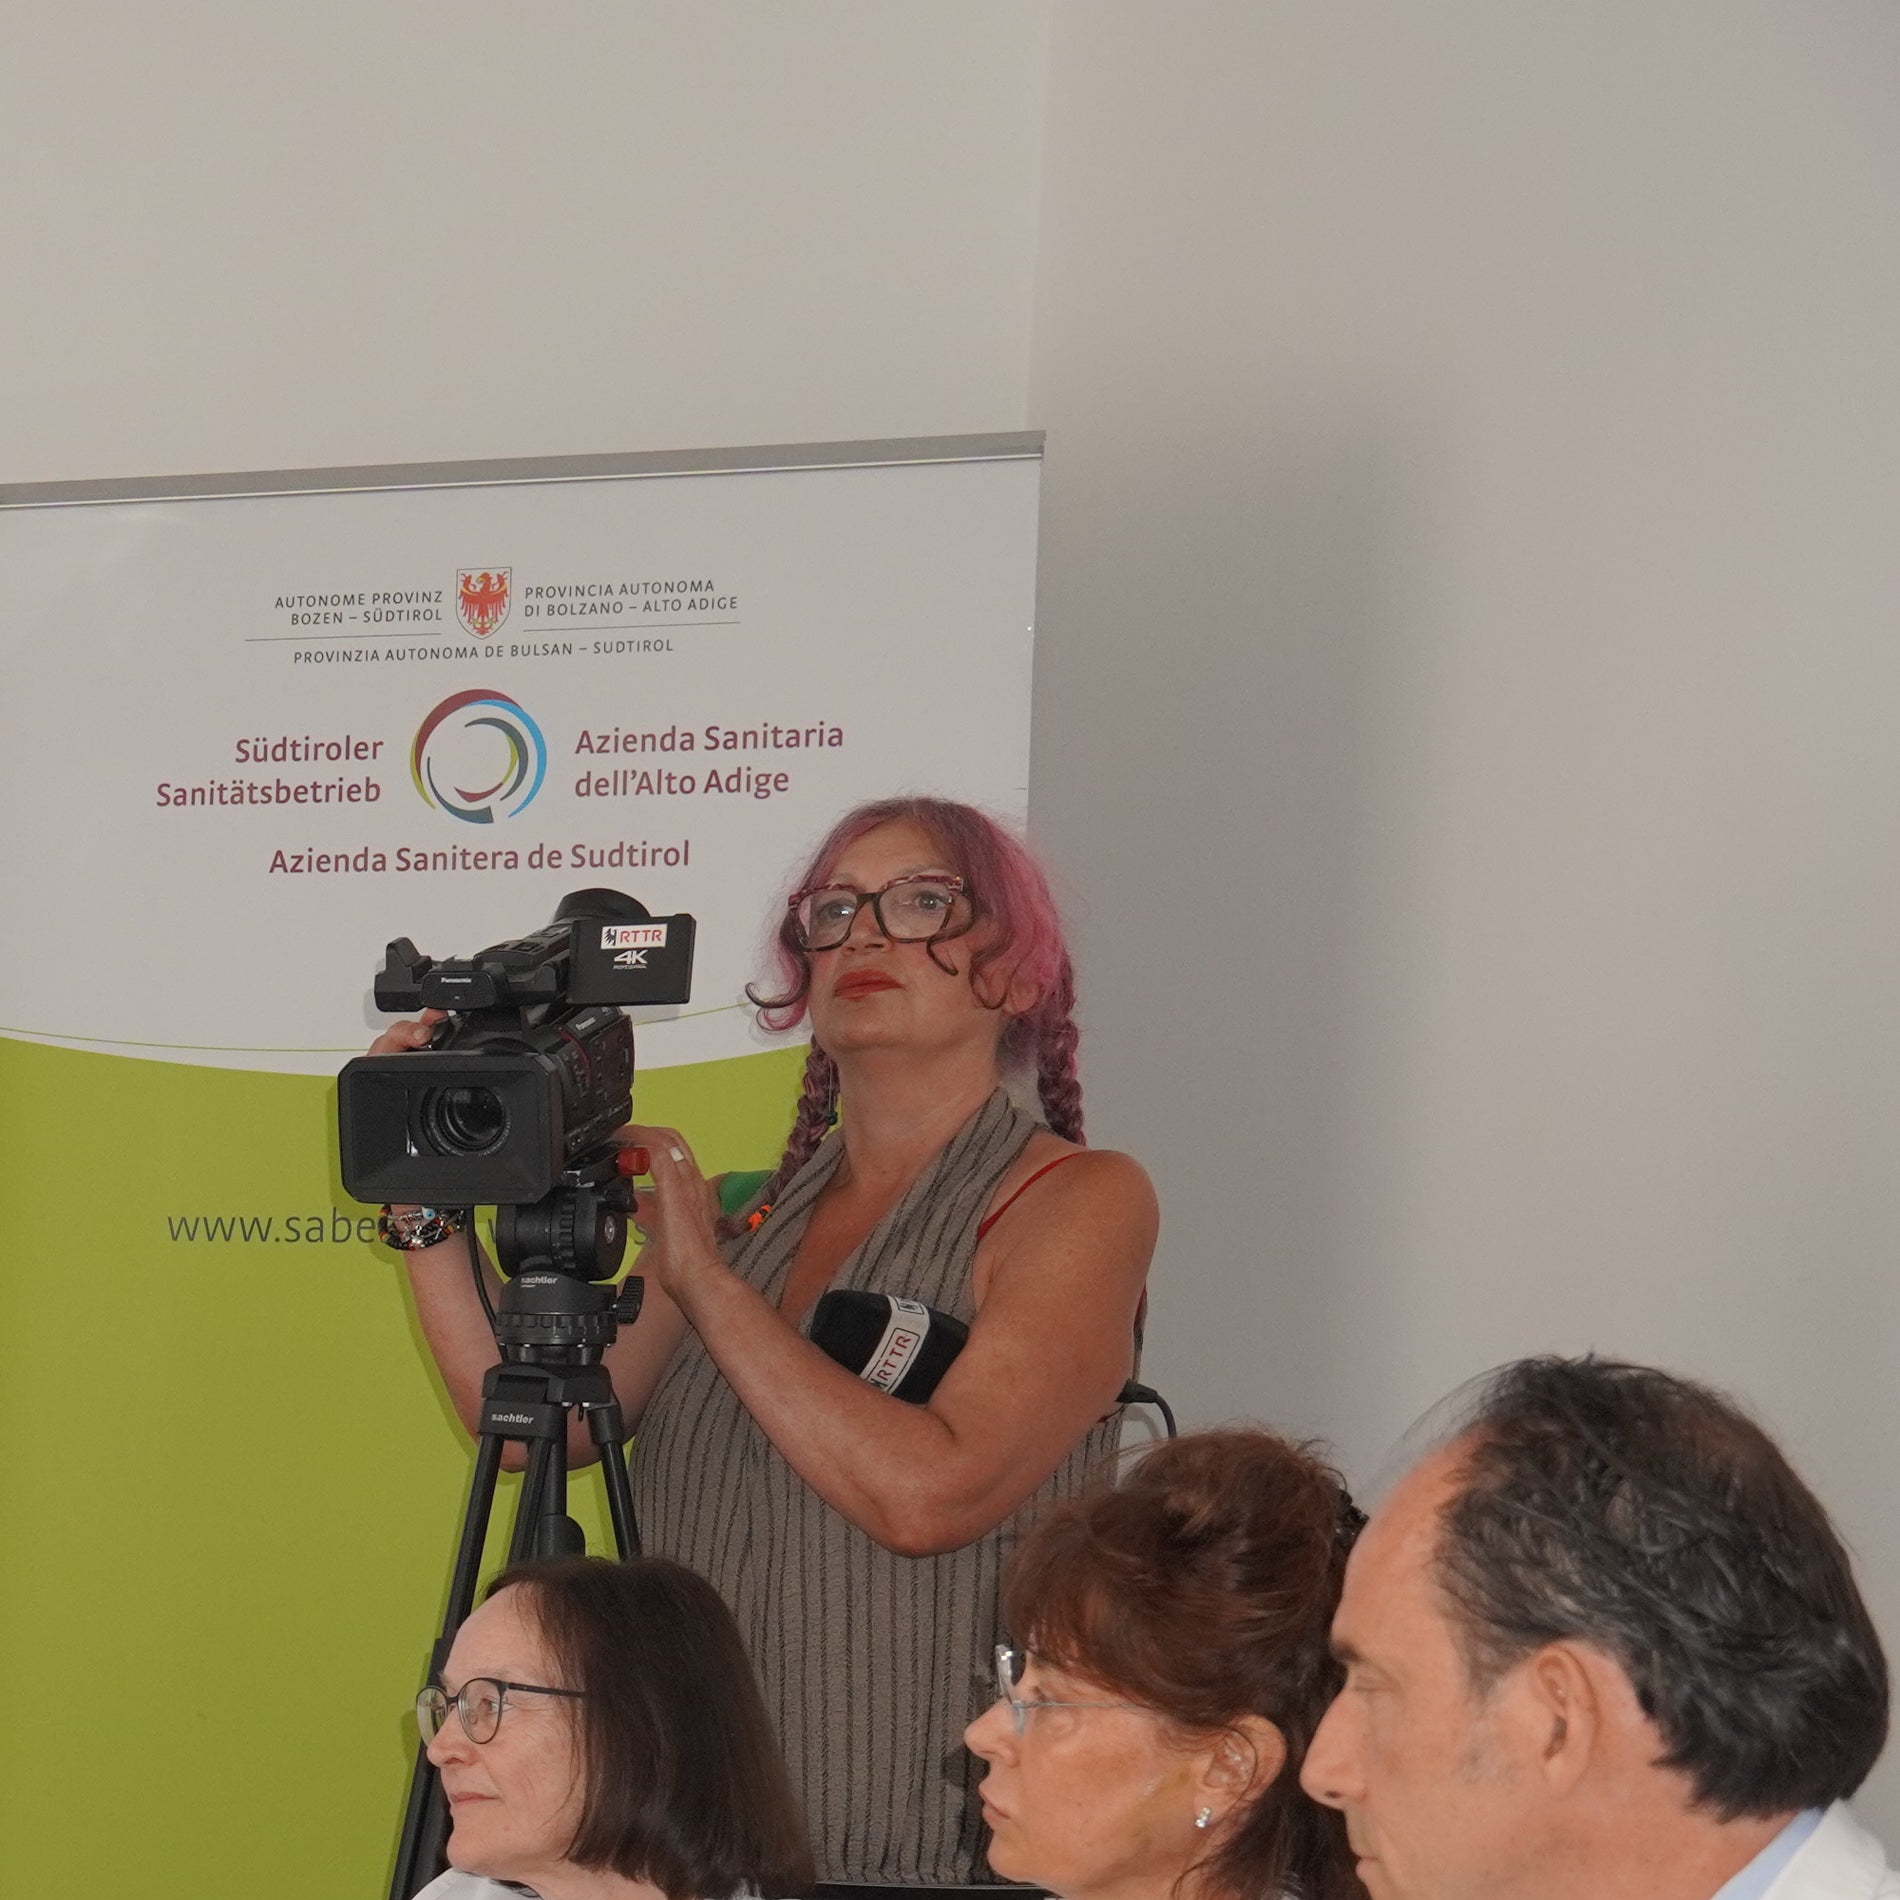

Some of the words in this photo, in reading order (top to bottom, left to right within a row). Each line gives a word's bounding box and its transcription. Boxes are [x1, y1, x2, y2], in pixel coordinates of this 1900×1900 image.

[274, 592, 366, 609] AUTONOME
[371, 590, 443, 605] PROVINZ
[524, 583, 614, 600] PROVINCIA
[618, 579, 715, 596] AUTONOMA
[290, 611, 343, 626] BOZEN
[362, 607, 443, 624] SÜDTIROL
[524, 604, 540, 618] DI
[546, 601, 624, 617] BOLZANO
[642, 598, 682, 613] ALTO
[687, 596, 738, 611] ADIGE
[293, 649, 380, 665] PROVINZIA
[384, 646, 479, 662] AUTONOMA
[484, 645, 505, 659] DE
[510, 642, 573, 658] BULSAN
[593, 638, 673, 655] SUDTIROL
[235, 734, 385, 764] Südtiroler
[574, 724, 695, 755] Azienda
[703, 720, 844, 752] Sanitaria
[156, 775, 381, 808] Sanitätsbetrieb
[702, 765, 790, 800] Adige
[268, 845, 387, 874] Azienda
[395, 844, 519, 872] Sanitera
[527, 842, 563, 870] de
[570, 839, 690, 869] Sudtirol
[619, 929, 663, 943] RTTR
[613, 949, 649, 965] 4K
[166, 1207, 376, 1244] www.sabe
[876, 1334, 912, 1382] RTTR
[491, 1412, 535, 1425] sachtler
